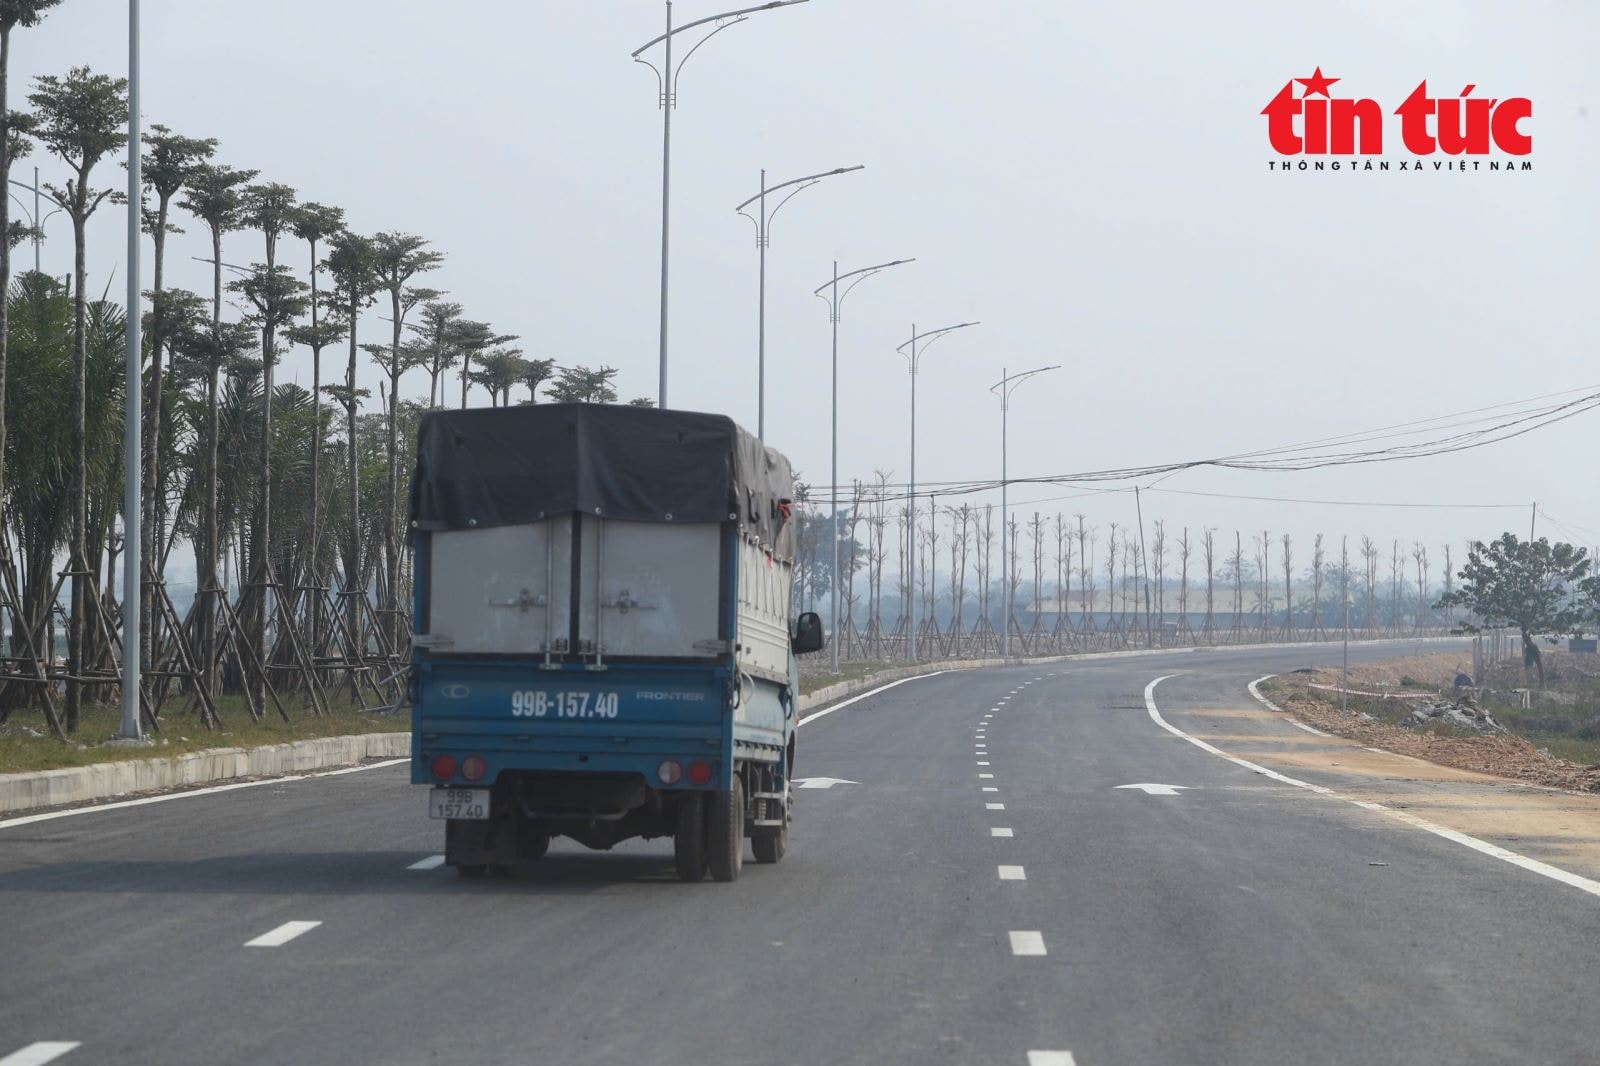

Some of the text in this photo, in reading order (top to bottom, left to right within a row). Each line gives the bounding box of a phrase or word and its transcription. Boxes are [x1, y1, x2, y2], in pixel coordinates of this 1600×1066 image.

[636, 691, 705, 701] FRONTIER
[512, 691, 619, 718] 99B-157.40
[447, 790, 473, 803] 99B
